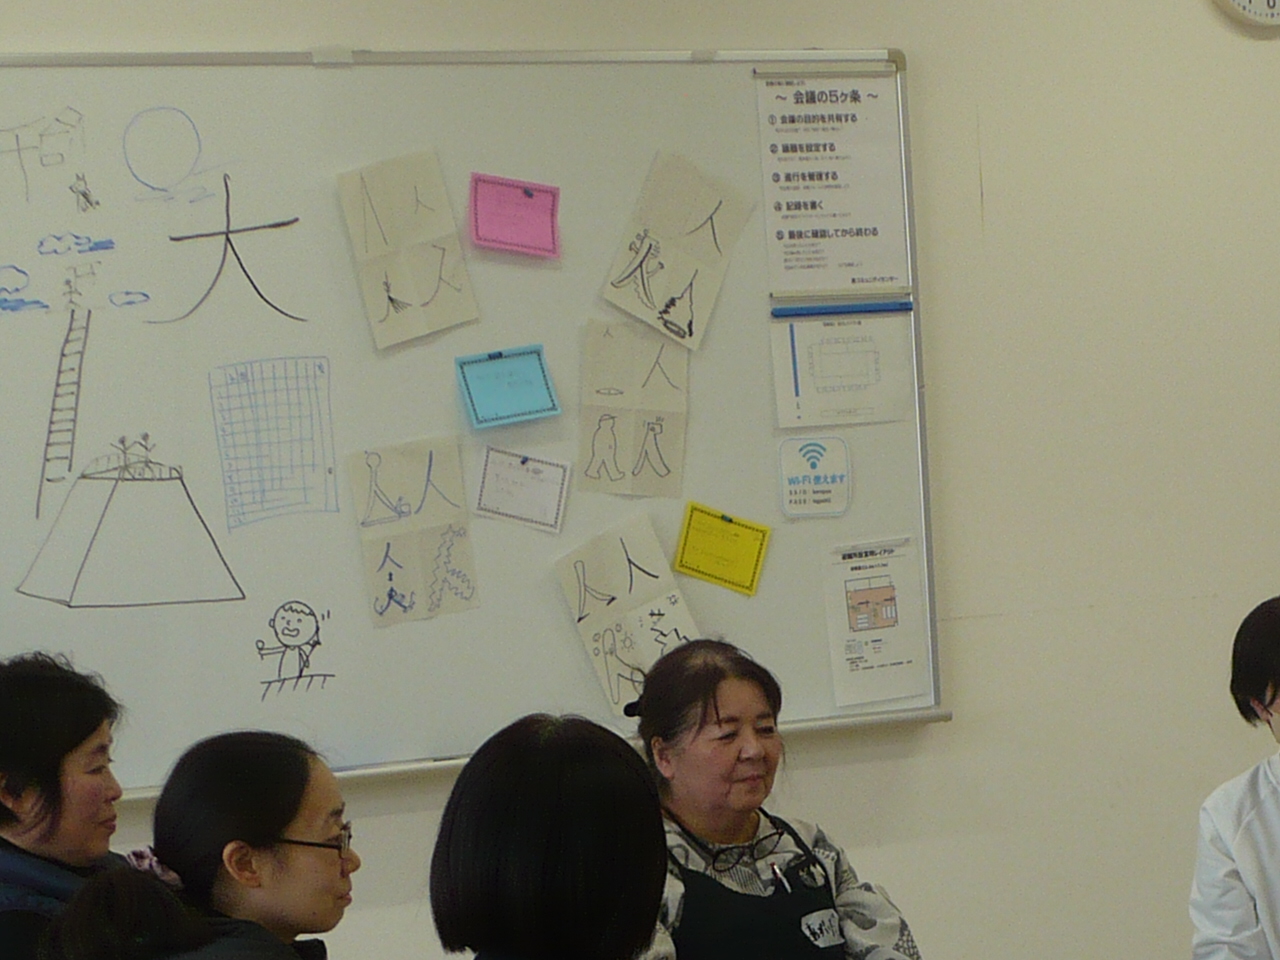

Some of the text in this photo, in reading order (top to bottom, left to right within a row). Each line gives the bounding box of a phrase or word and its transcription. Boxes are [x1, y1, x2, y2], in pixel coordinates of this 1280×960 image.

[780, 113, 858, 124] 会議の目的を共有する
